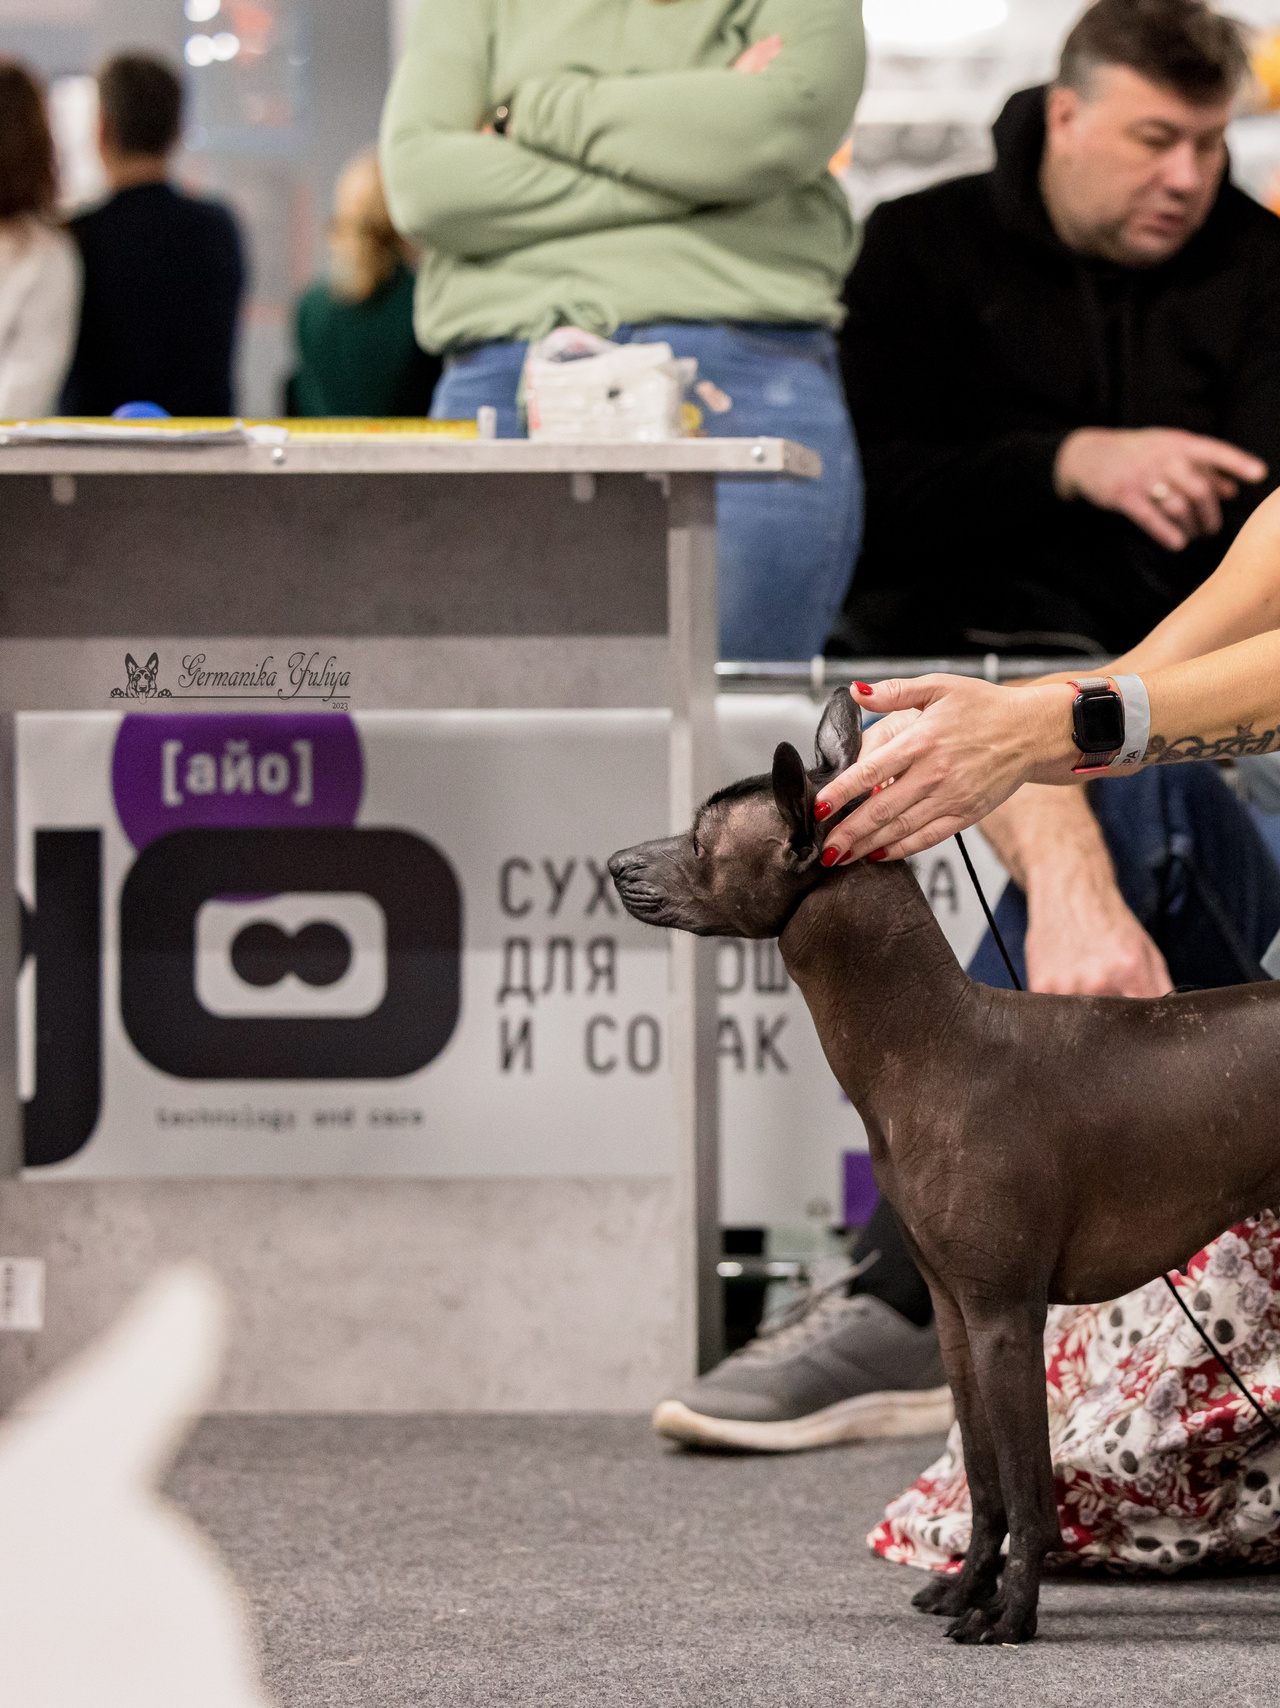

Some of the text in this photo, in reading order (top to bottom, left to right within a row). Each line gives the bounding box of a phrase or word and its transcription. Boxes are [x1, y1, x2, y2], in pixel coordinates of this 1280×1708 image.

[496, 936, 617, 1006] ДЛЯ
[502, 1013, 791, 1075] И СОАК
